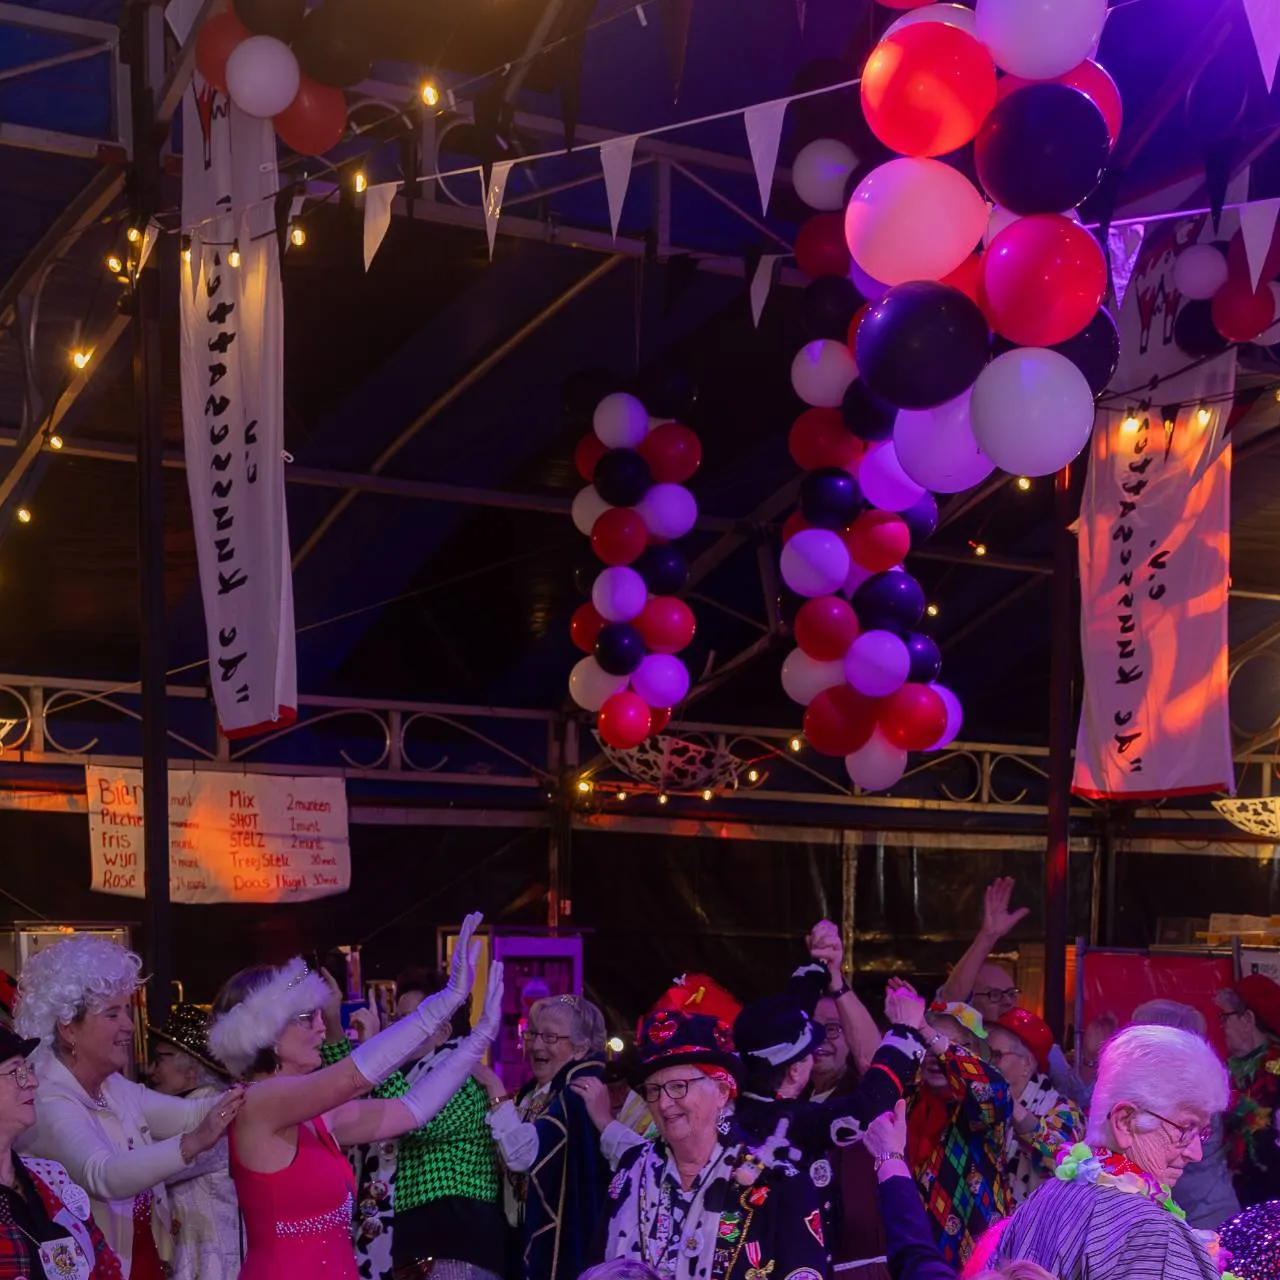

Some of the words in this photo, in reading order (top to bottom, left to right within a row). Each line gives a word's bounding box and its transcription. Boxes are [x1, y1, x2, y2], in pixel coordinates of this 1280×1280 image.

[98, 778, 144, 806] Bier
[229, 790, 255, 809] Mix
[101, 809, 144, 827] Pitche
[229, 813, 259, 830] SHOT
